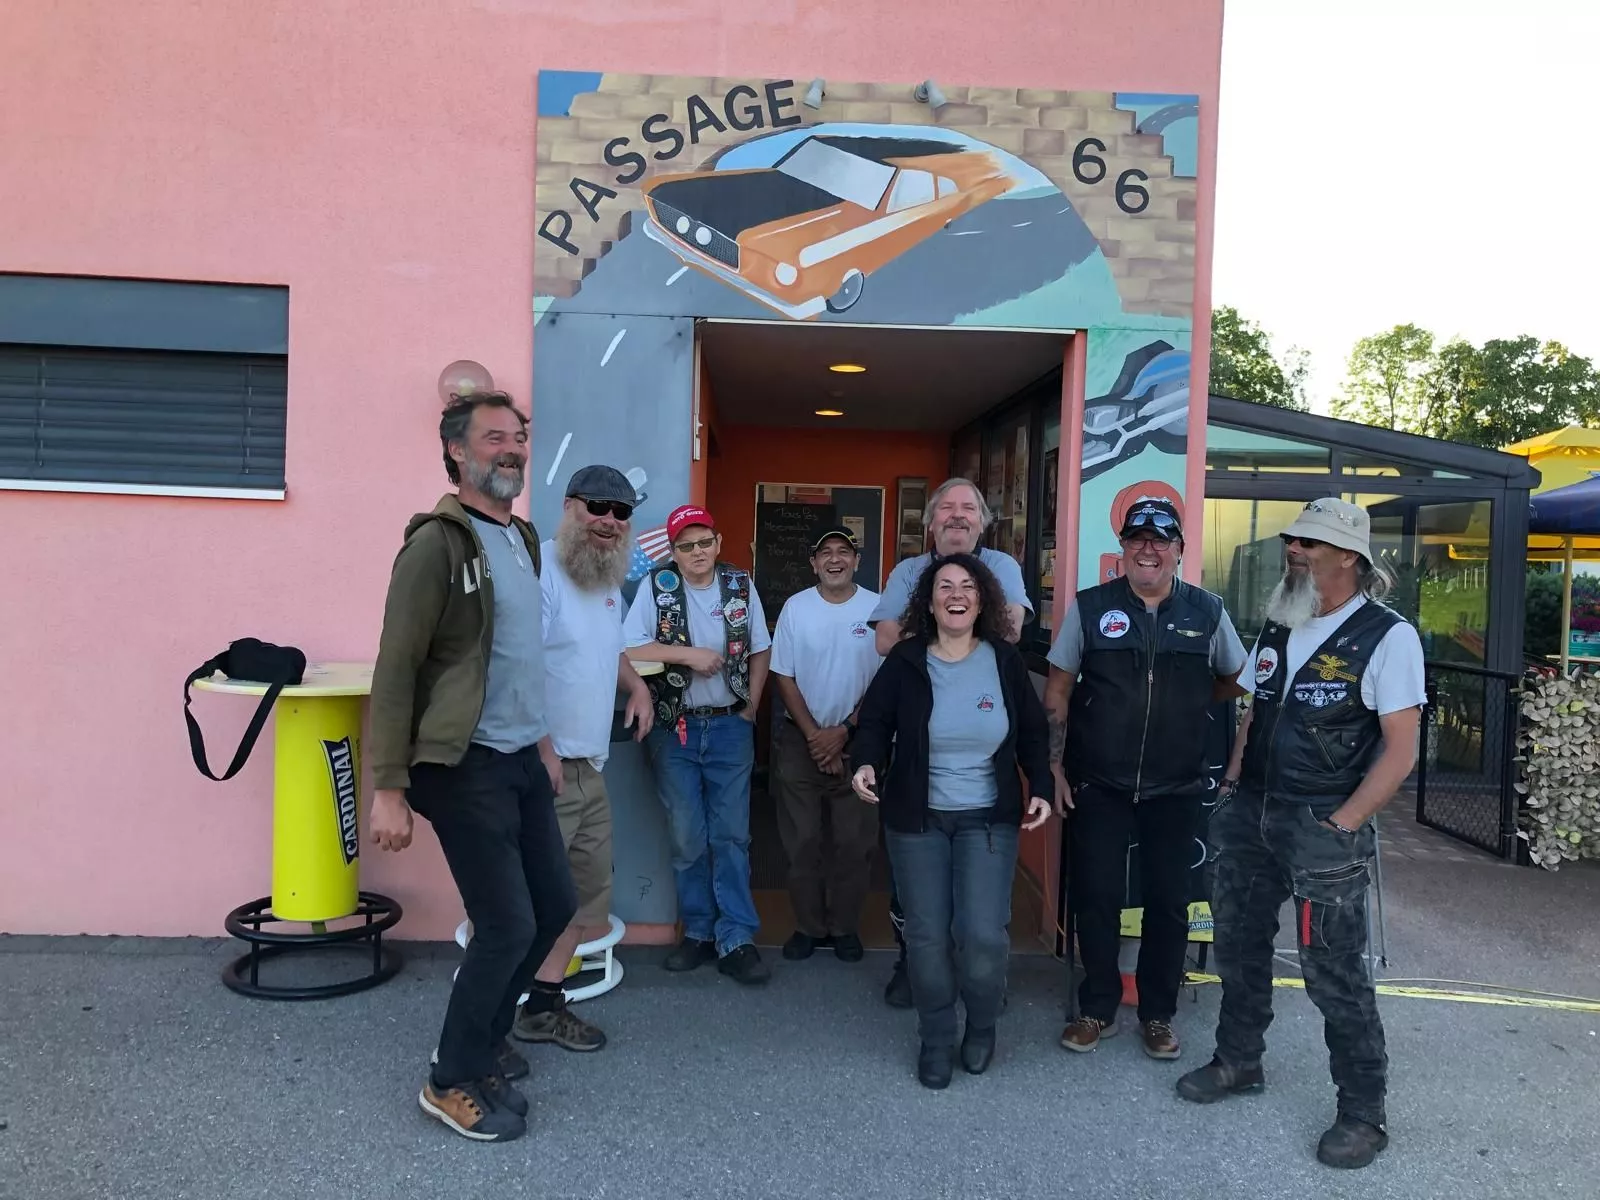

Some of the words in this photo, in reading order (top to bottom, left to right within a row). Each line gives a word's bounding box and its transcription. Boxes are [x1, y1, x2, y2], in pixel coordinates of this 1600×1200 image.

[537, 79, 802, 256] PASSAGE
[1071, 137, 1150, 214] 66
[331, 740, 358, 856] CARDINAL
